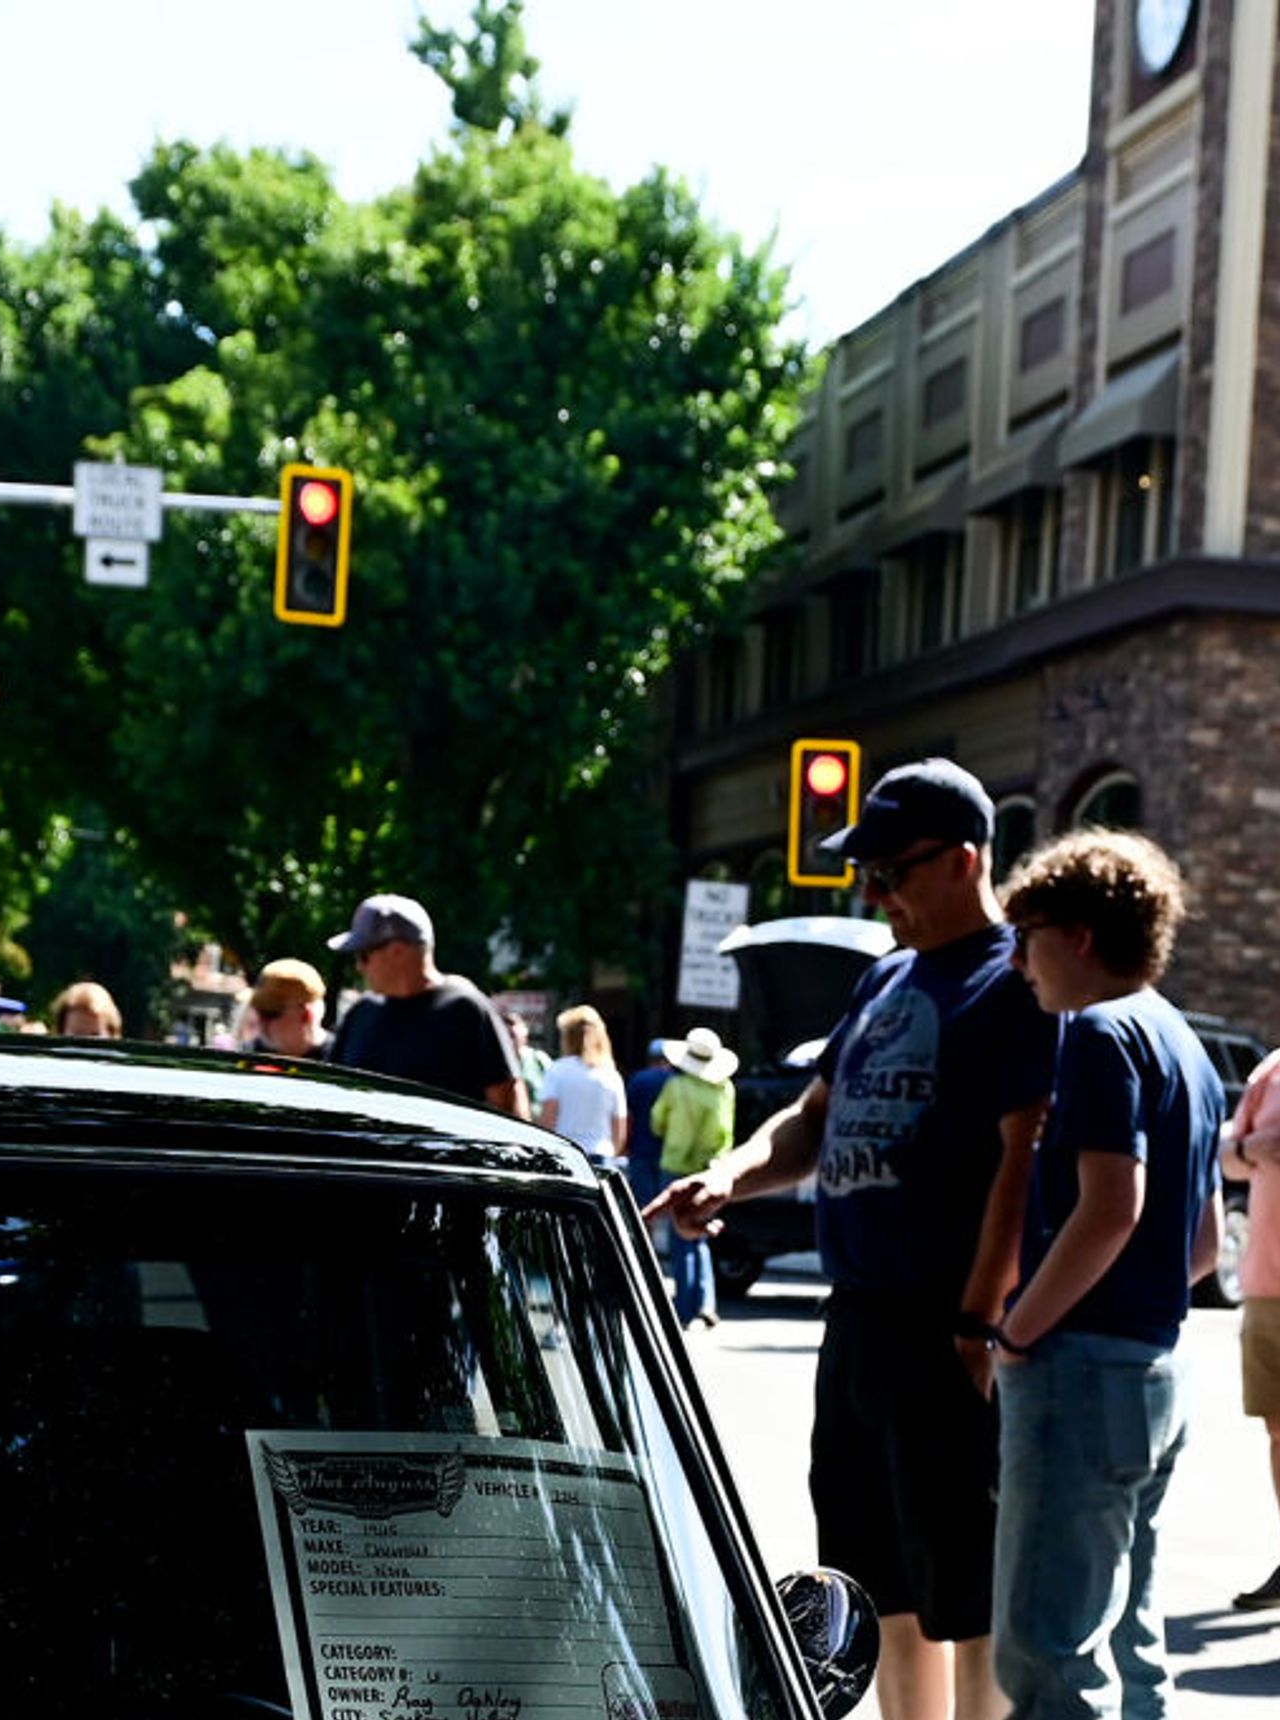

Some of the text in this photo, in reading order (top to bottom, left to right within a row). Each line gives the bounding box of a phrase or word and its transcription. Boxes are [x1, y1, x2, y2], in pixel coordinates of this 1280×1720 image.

[474, 1482, 530, 1499] VEHICLE
[300, 1519, 343, 1535] YEAR:
[303, 1539, 351, 1555] MAKE:
[307, 1559, 363, 1575] MODEL:
[310, 1580, 447, 1598] SPECIAL FEATURES:
[320, 1643, 399, 1661] CATEGORY:
[323, 1665, 396, 1682] CATEGORY
[327, 1686, 386, 1704] OWNER:
[391, 1685, 434, 1715] Ray
